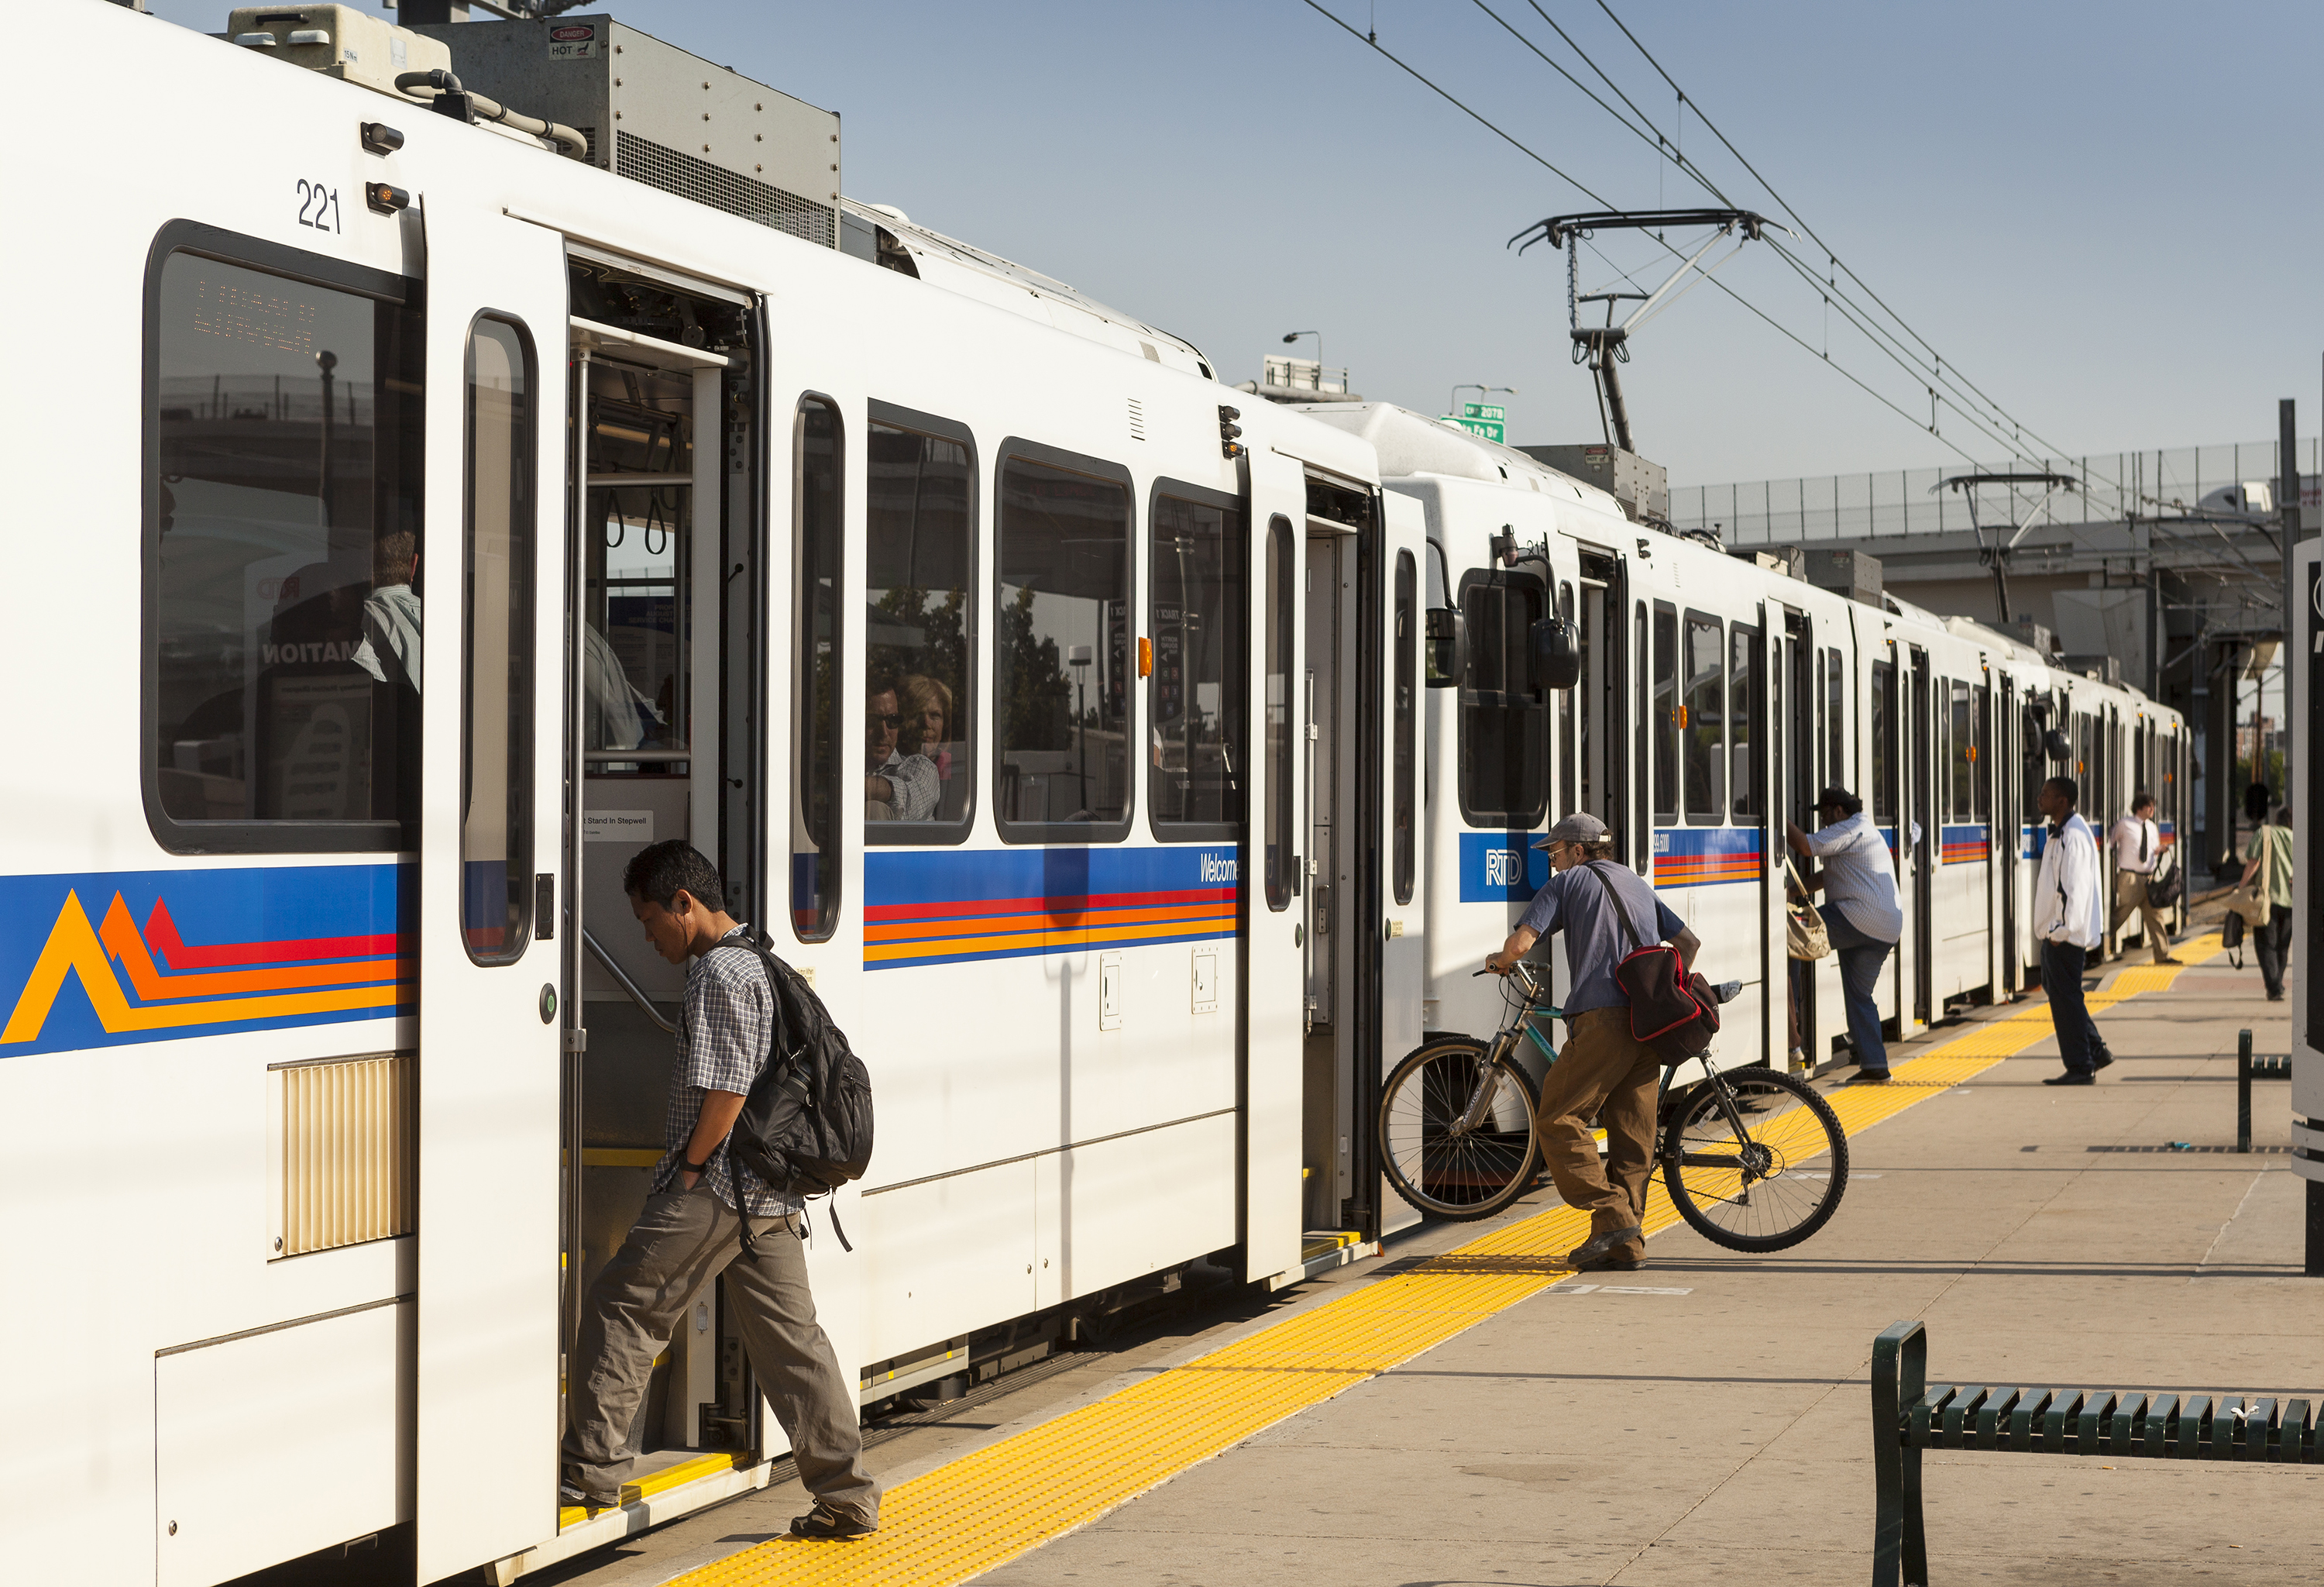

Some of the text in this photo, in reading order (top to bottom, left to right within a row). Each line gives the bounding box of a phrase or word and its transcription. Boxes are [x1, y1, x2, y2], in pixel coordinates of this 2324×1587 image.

[552, 46, 572, 55] HOT
[297, 178, 340, 235] 221
[1487, 426, 1498, 438] Dr
[1201, 853, 1239, 883] Welcome
[1486, 849, 1522, 886] RTD
